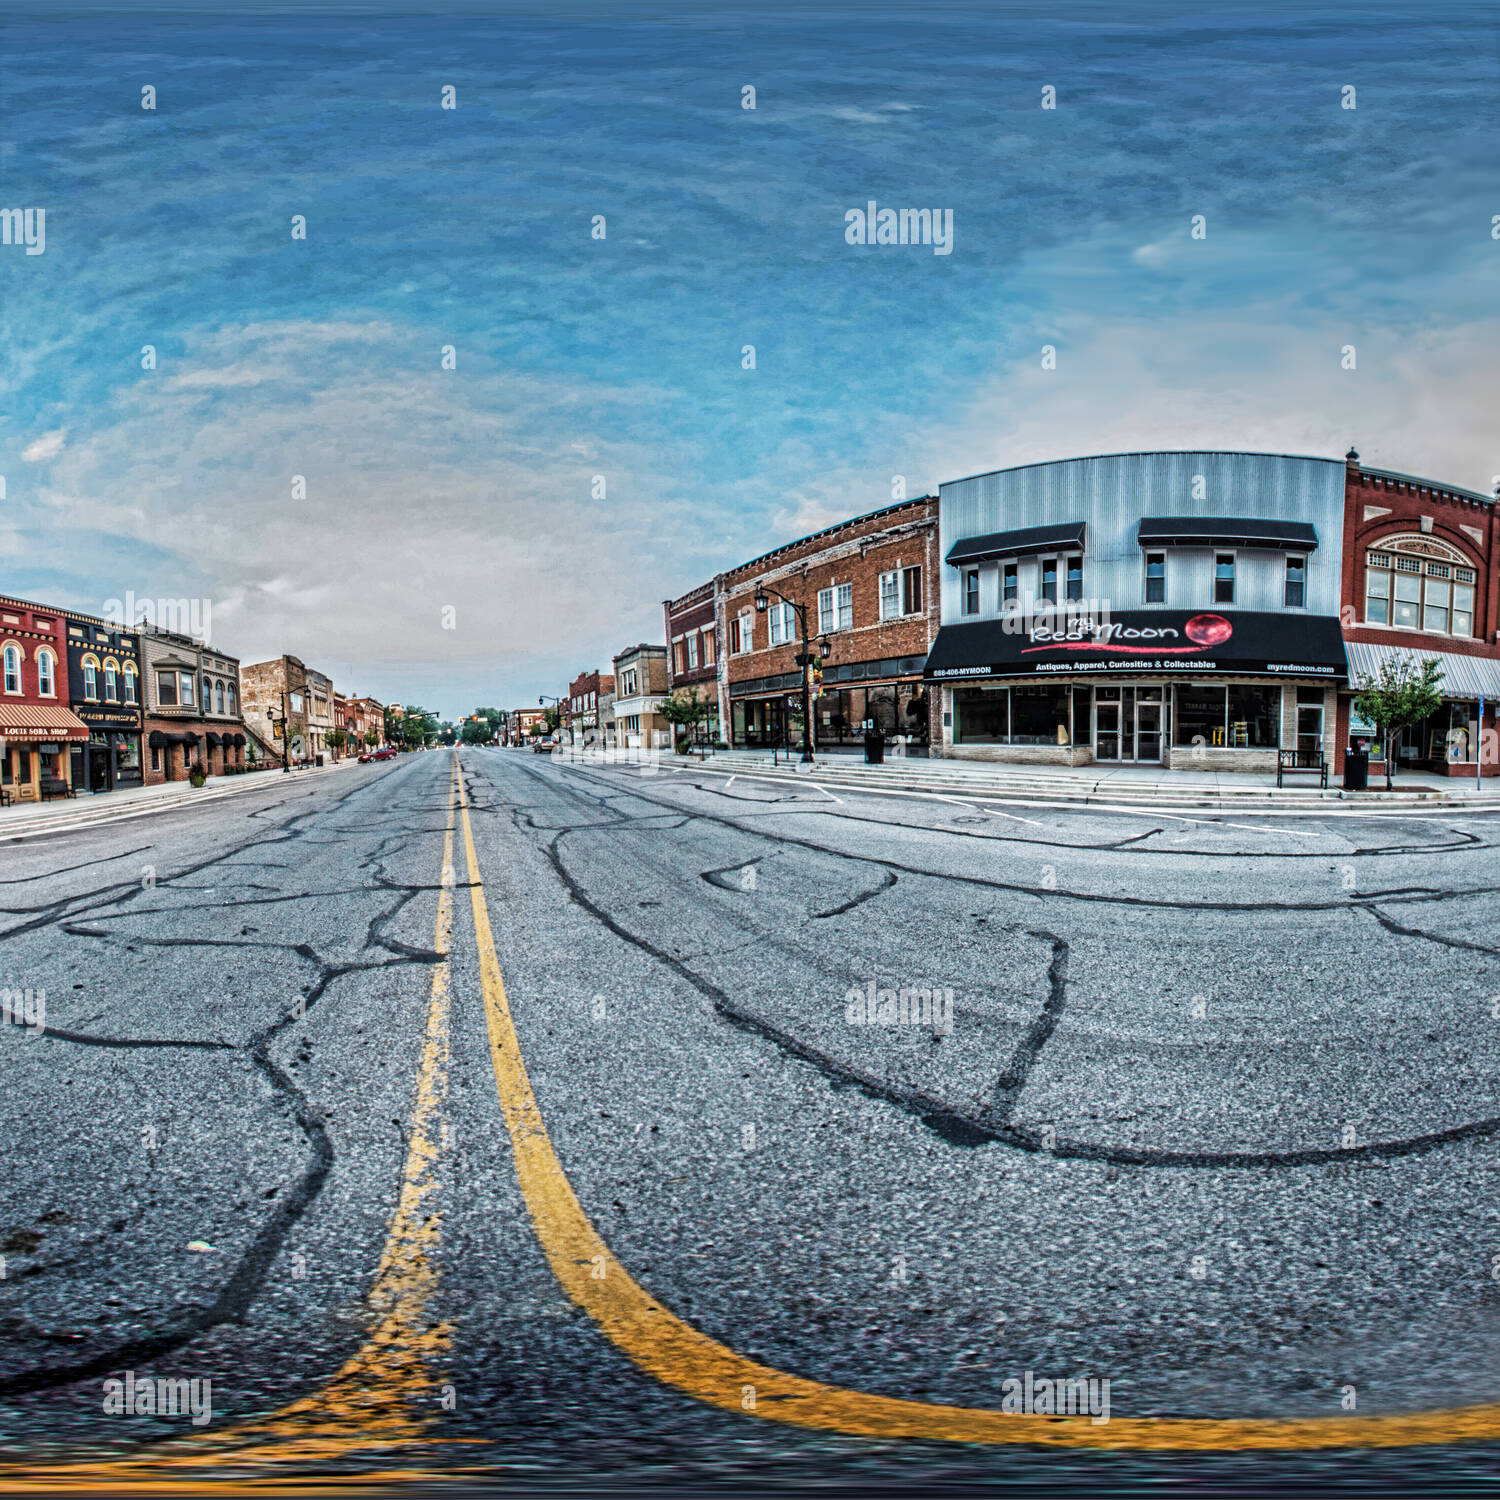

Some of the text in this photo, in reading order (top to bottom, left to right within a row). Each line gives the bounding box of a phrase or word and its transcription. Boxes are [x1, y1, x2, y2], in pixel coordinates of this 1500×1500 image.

[1068, 617, 1095, 631] my
[1030, 623, 1179, 643] Red Moon
[1036, 660, 1216, 671] Antiques, Apparel, Curiosities & Collectables
[1267, 664, 1335, 673] myredmoon.com
